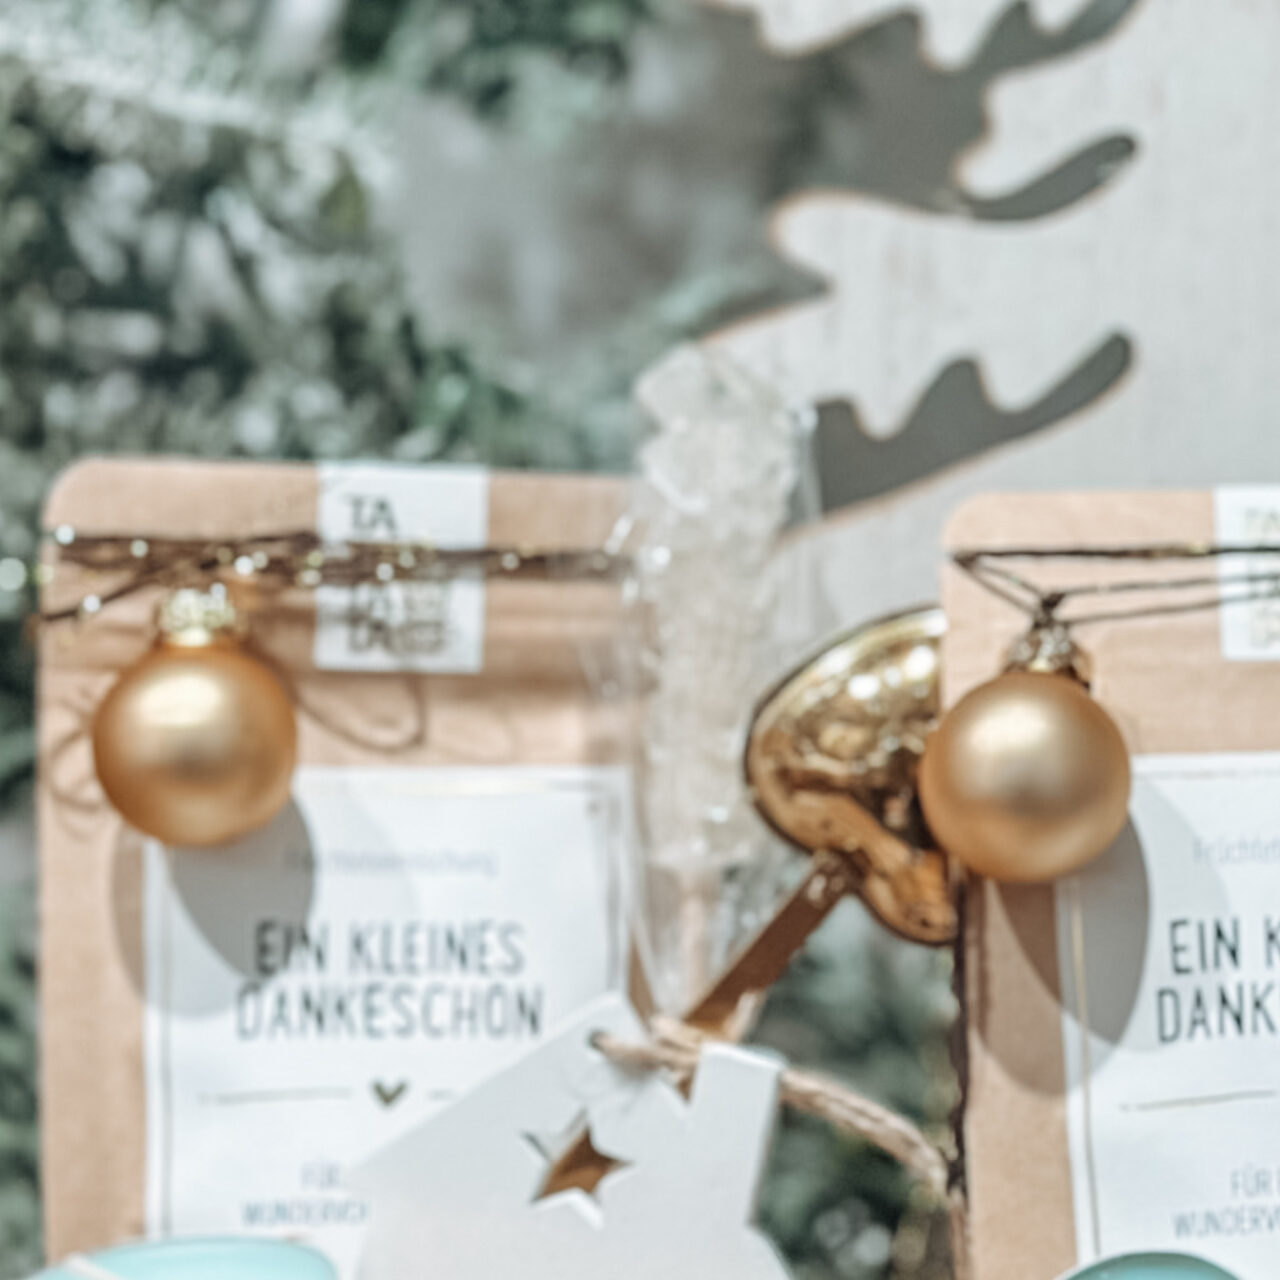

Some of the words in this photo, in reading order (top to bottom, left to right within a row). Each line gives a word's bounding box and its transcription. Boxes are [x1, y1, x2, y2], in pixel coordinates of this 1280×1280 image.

[255, 918, 329, 977] EIN
[348, 918, 526, 976] KLEINES
[1169, 915, 1241, 975] EIN
